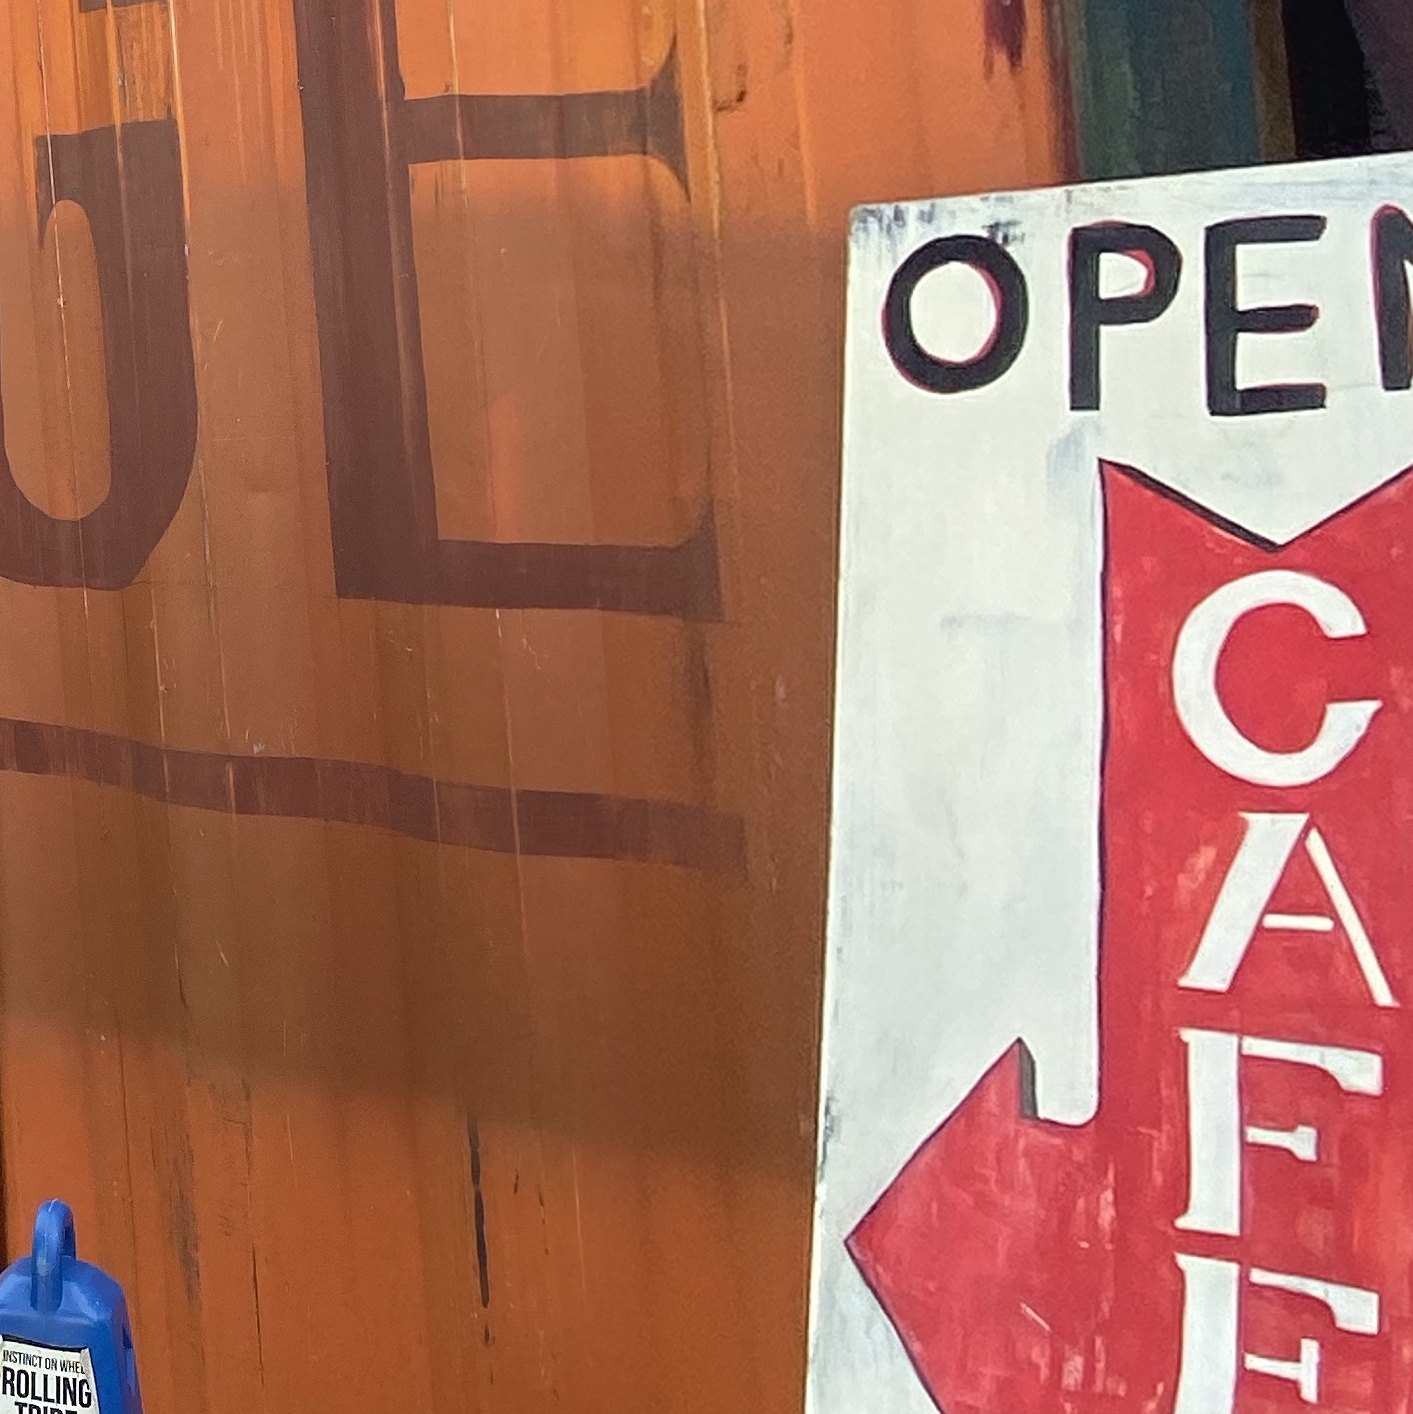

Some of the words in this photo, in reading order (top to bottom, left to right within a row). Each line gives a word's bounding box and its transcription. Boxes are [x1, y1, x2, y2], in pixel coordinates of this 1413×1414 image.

[1, 1349, 43, 1370] INSTINCT
[44, 1356, 59, 1372] ON
[1, 1365, 93, 1409] ROLLING
